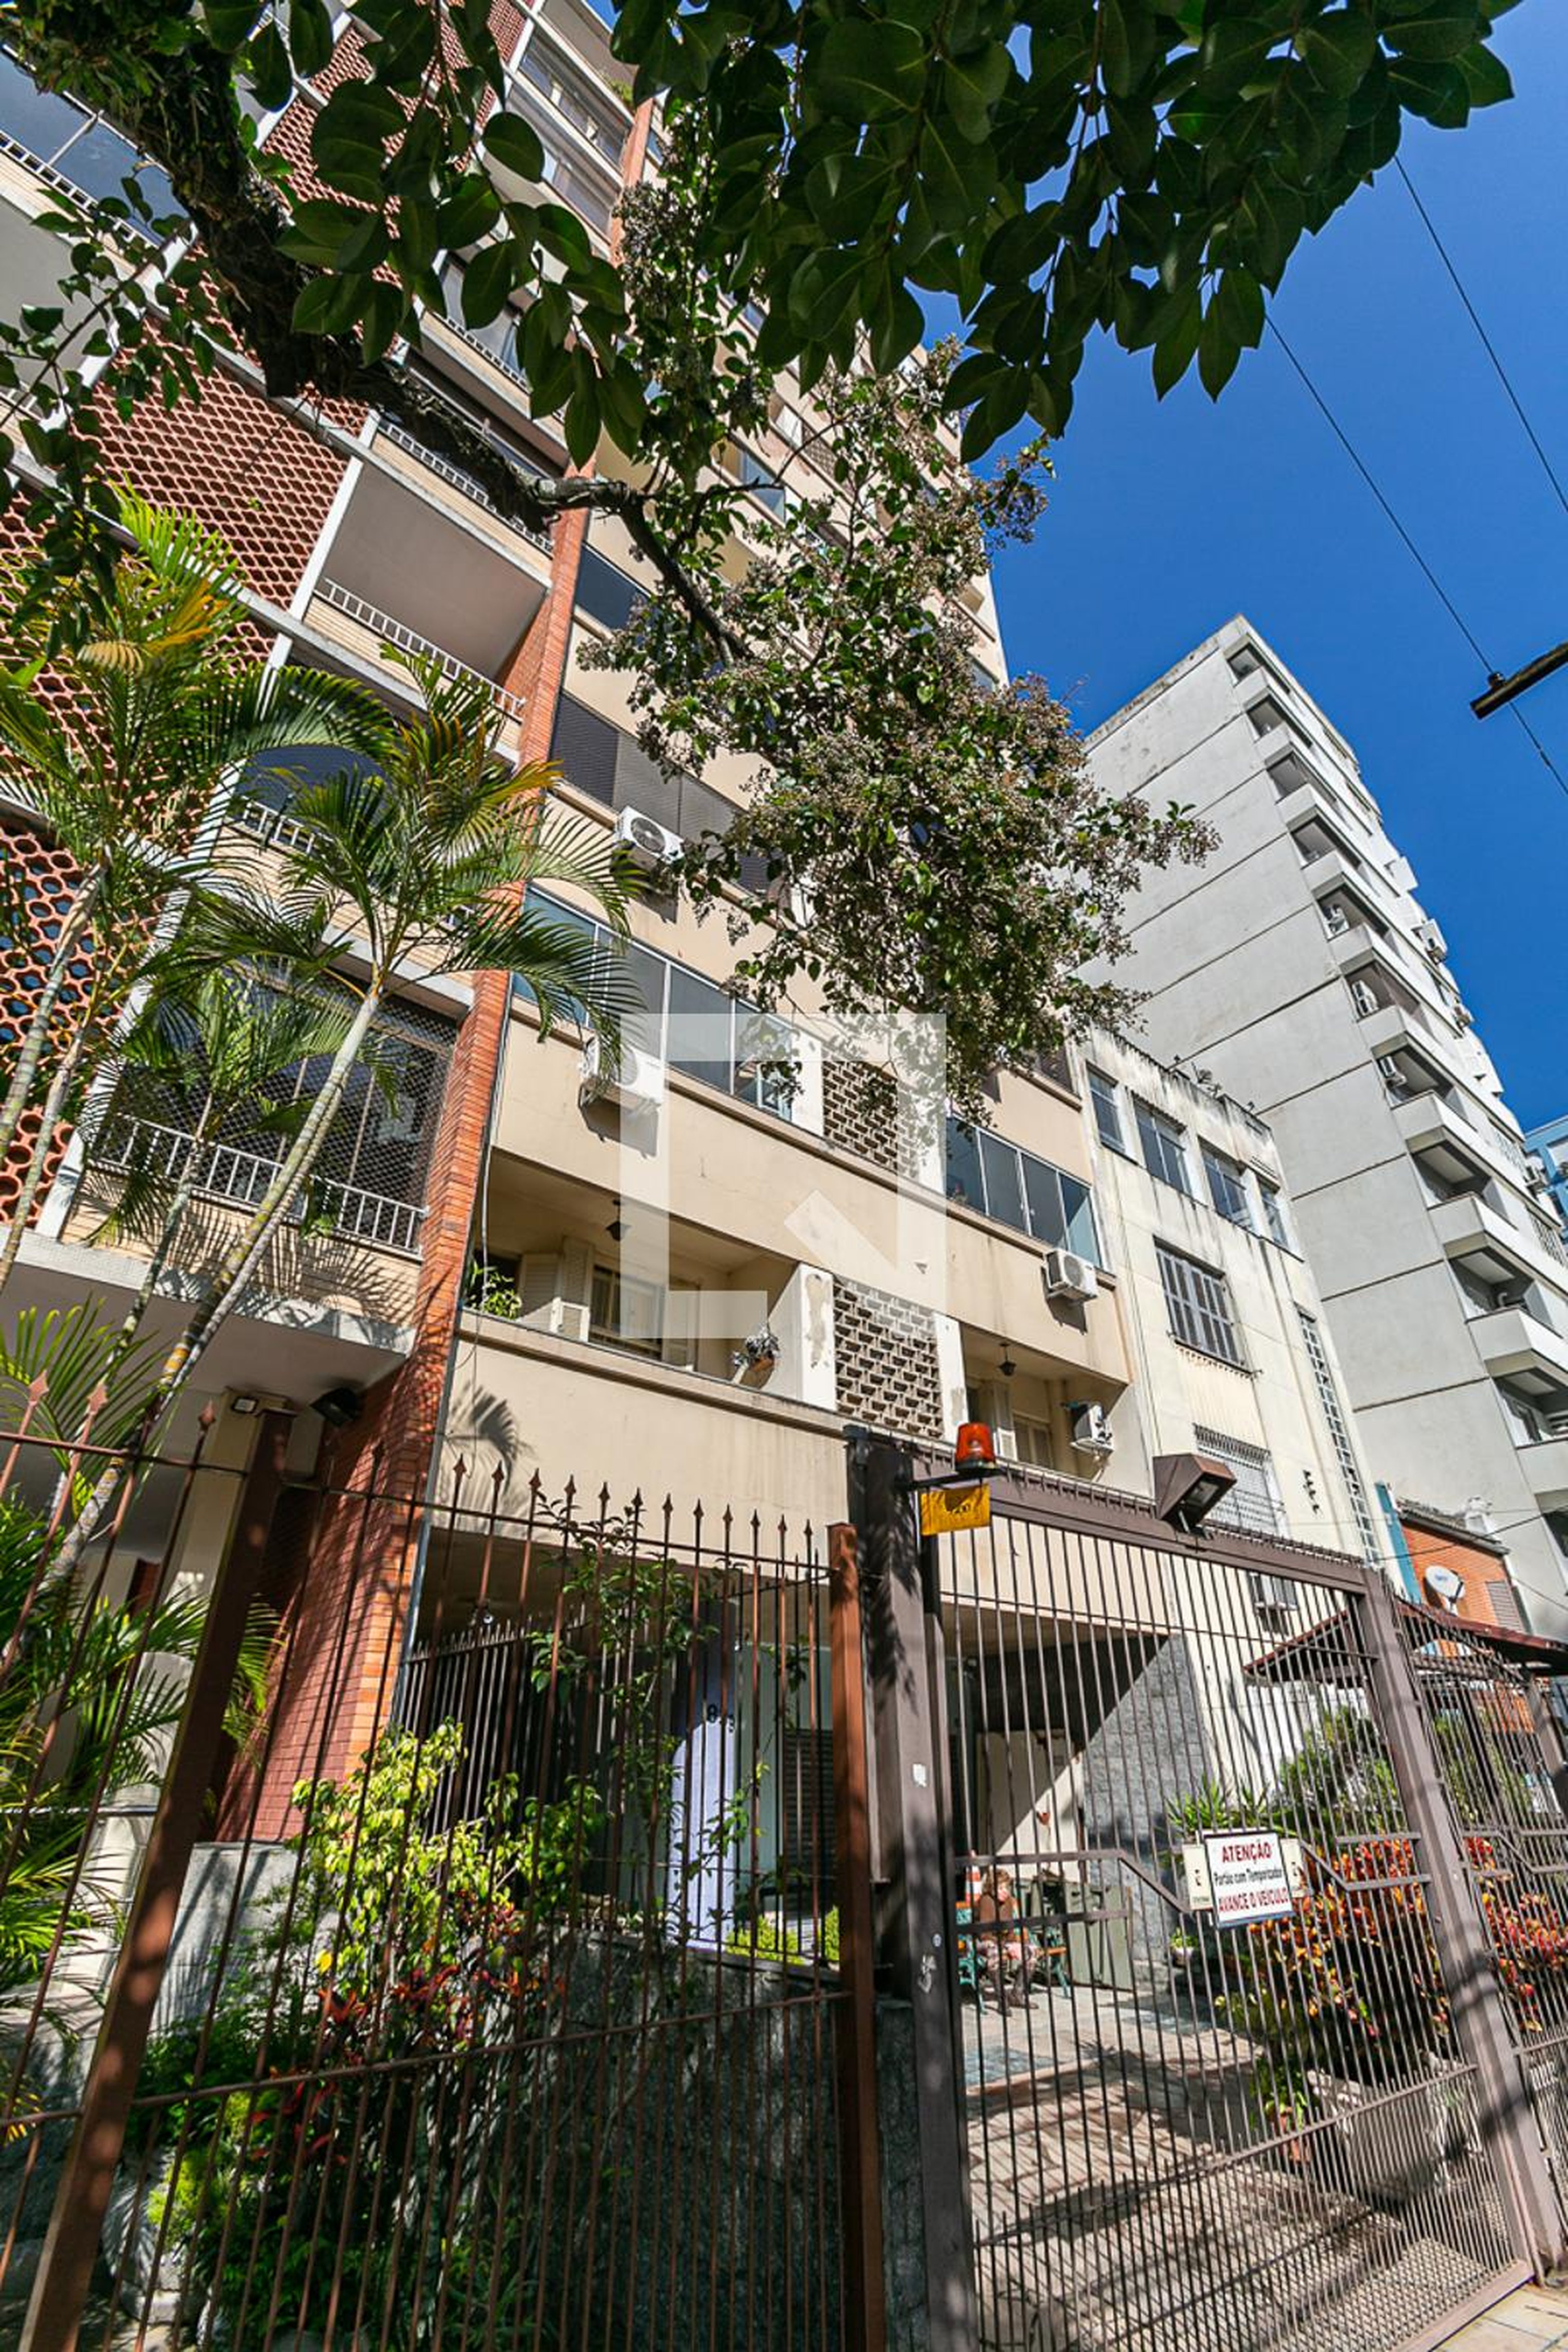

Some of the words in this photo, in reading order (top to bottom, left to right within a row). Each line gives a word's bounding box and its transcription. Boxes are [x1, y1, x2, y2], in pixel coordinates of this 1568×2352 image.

[1223, 1840, 1272, 1864] ATENÇÃO
[1218, 1893, 1249, 1912] AVANCE
[1250, 1891, 1256, 1908] O
